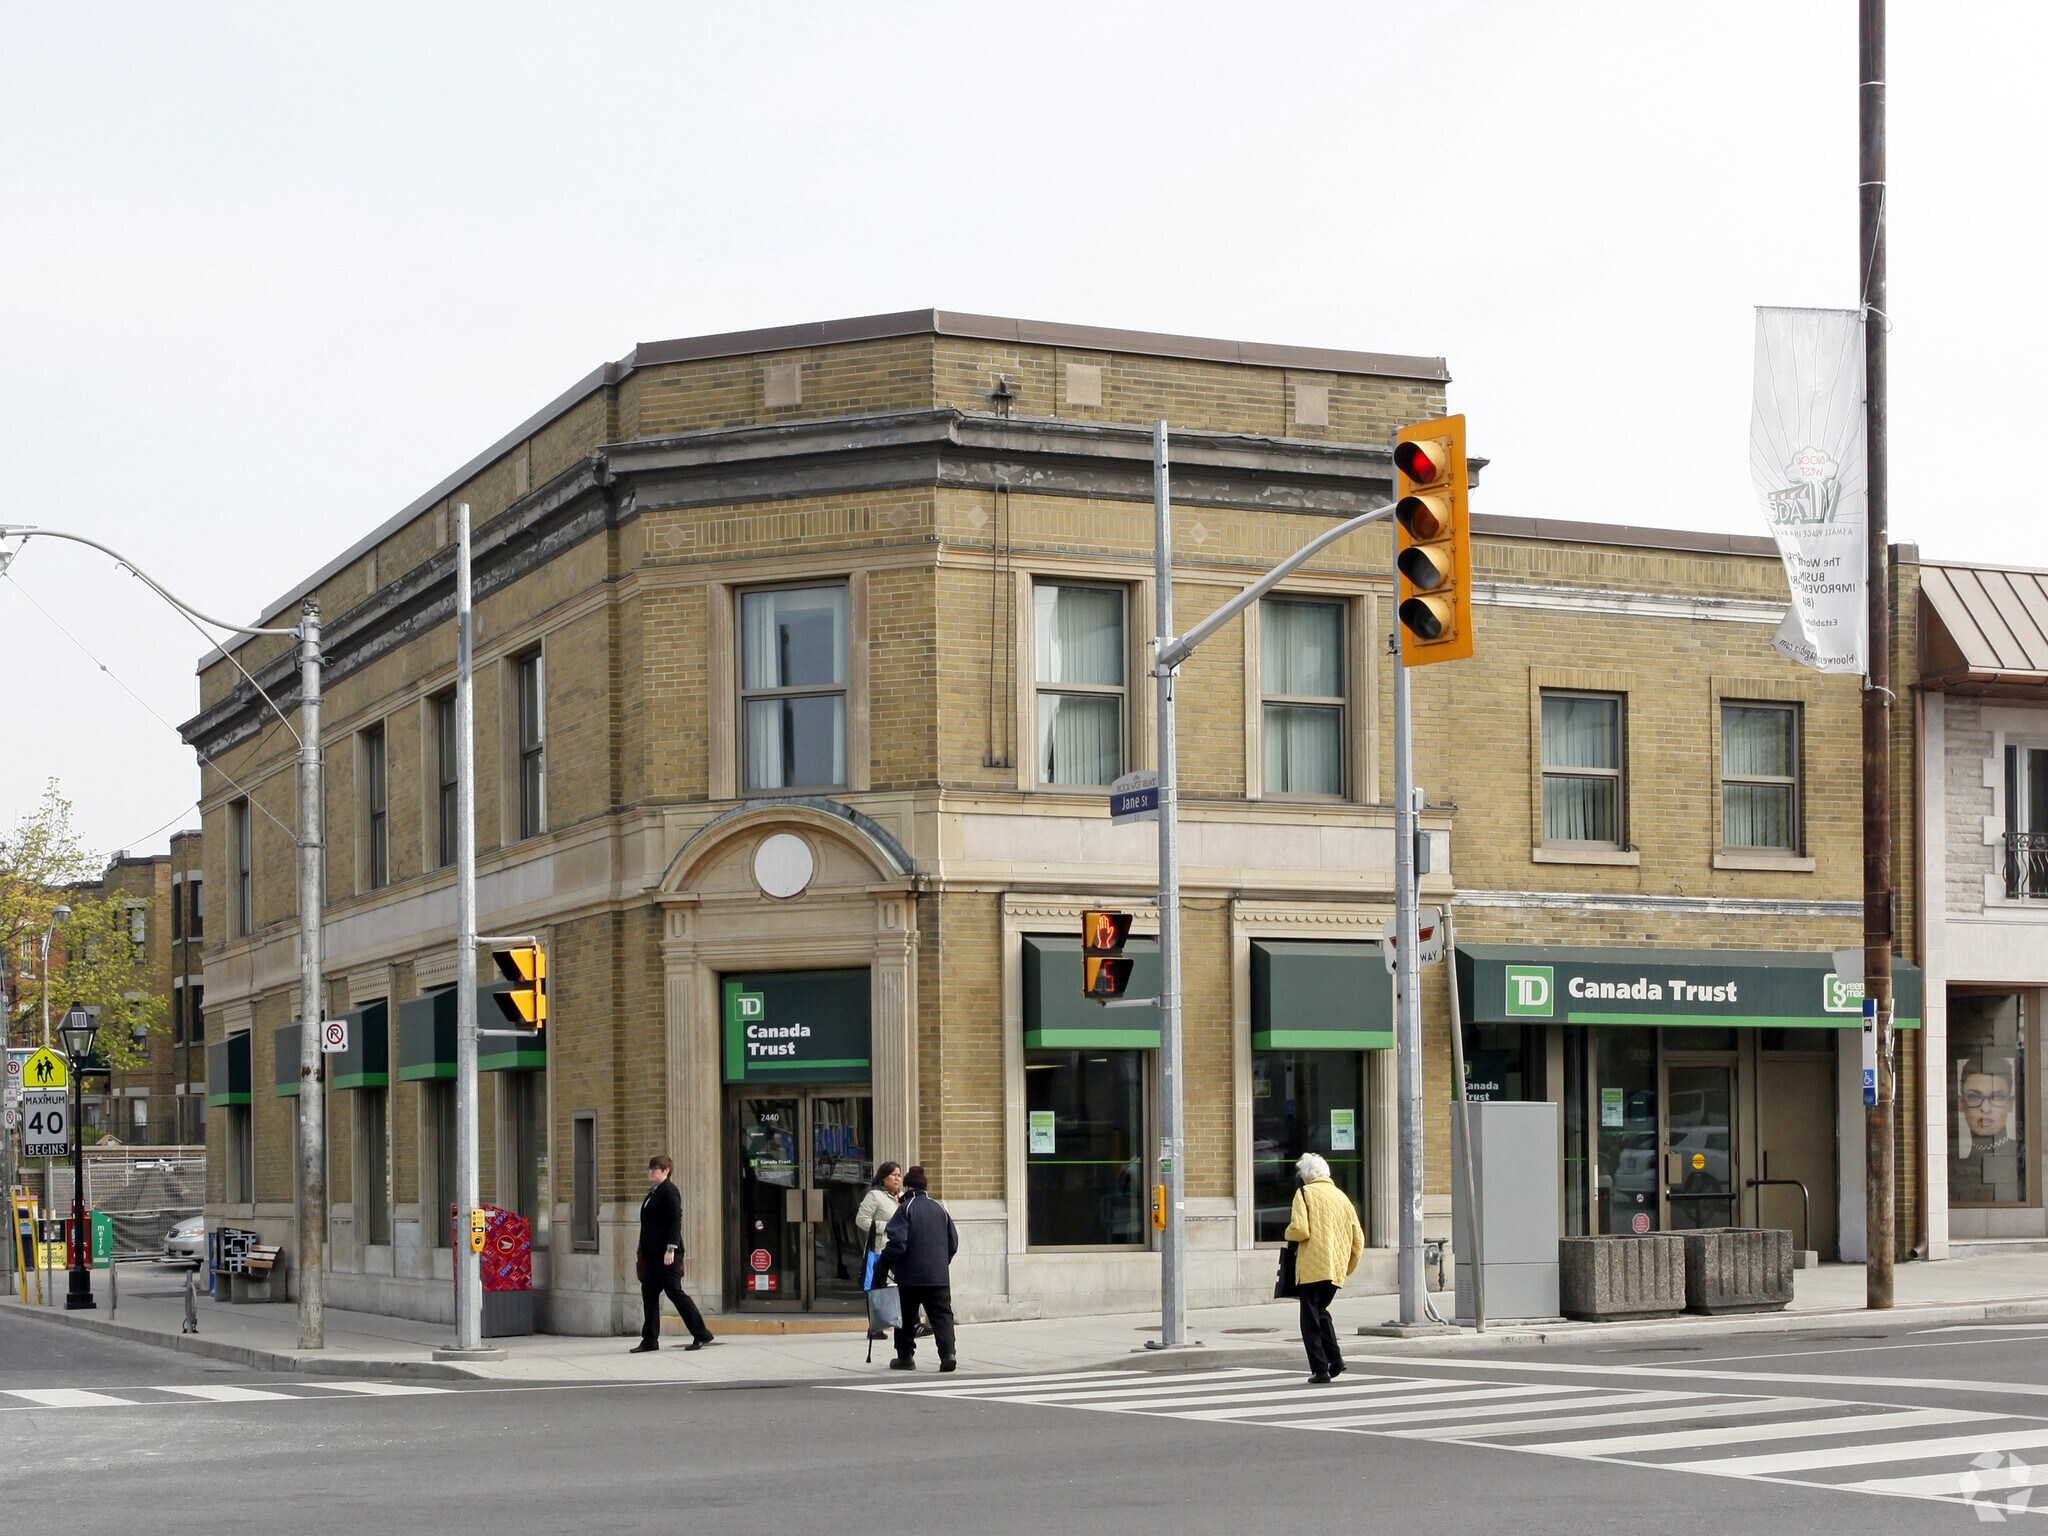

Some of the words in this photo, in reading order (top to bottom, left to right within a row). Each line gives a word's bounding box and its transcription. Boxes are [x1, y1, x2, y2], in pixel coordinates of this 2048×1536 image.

[1121, 796, 1140, 811] Jane
[1141, 795, 1148, 807] St
[1420, 950, 1437, 963] WAY
[1510, 975, 1549, 1006] TD
[1568, 977, 1663, 1001] Canada
[1668, 980, 1738, 1002] Trust
[737, 998, 761, 1016] TD
[746, 1023, 811, 1039] Canada
[747, 1041, 796, 1056] Trust
[25, 1095, 65, 1105] MAXIMUM
[28, 1111, 64, 1135] 40
[760, 1113, 780, 1122] 2440
[28, 1144, 65, 1155] BEGINS
